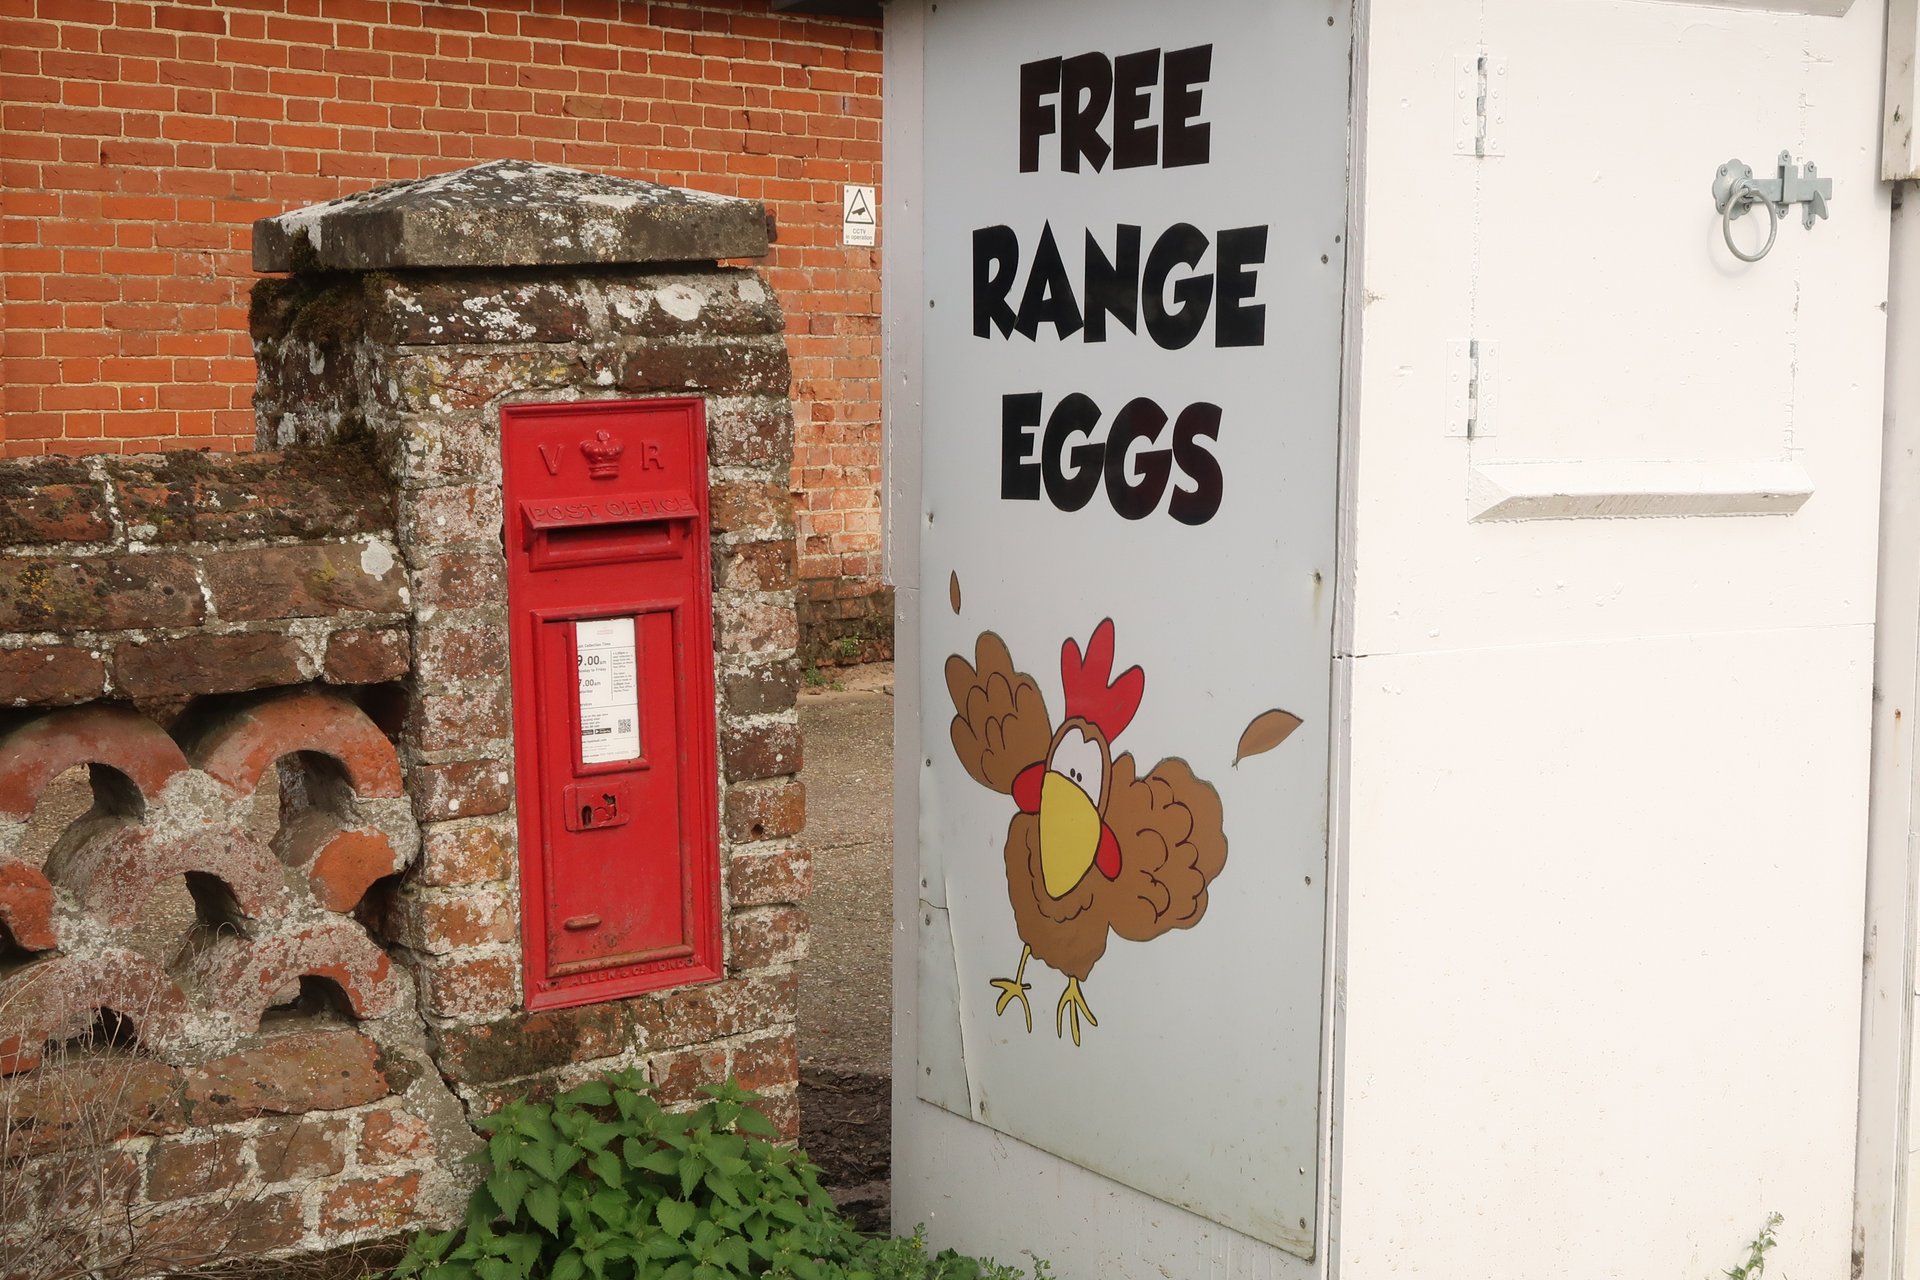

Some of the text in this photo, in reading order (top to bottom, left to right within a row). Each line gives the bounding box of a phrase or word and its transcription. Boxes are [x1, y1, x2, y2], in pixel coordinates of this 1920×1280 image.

[1019, 43, 1213, 174] FREE
[972, 219, 1268, 350] RANGE
[528, 497, 694, 522] POST OFFICE
[537, 440, 665, 476] V R
[1001, 392, 1224, 526] EGGS
